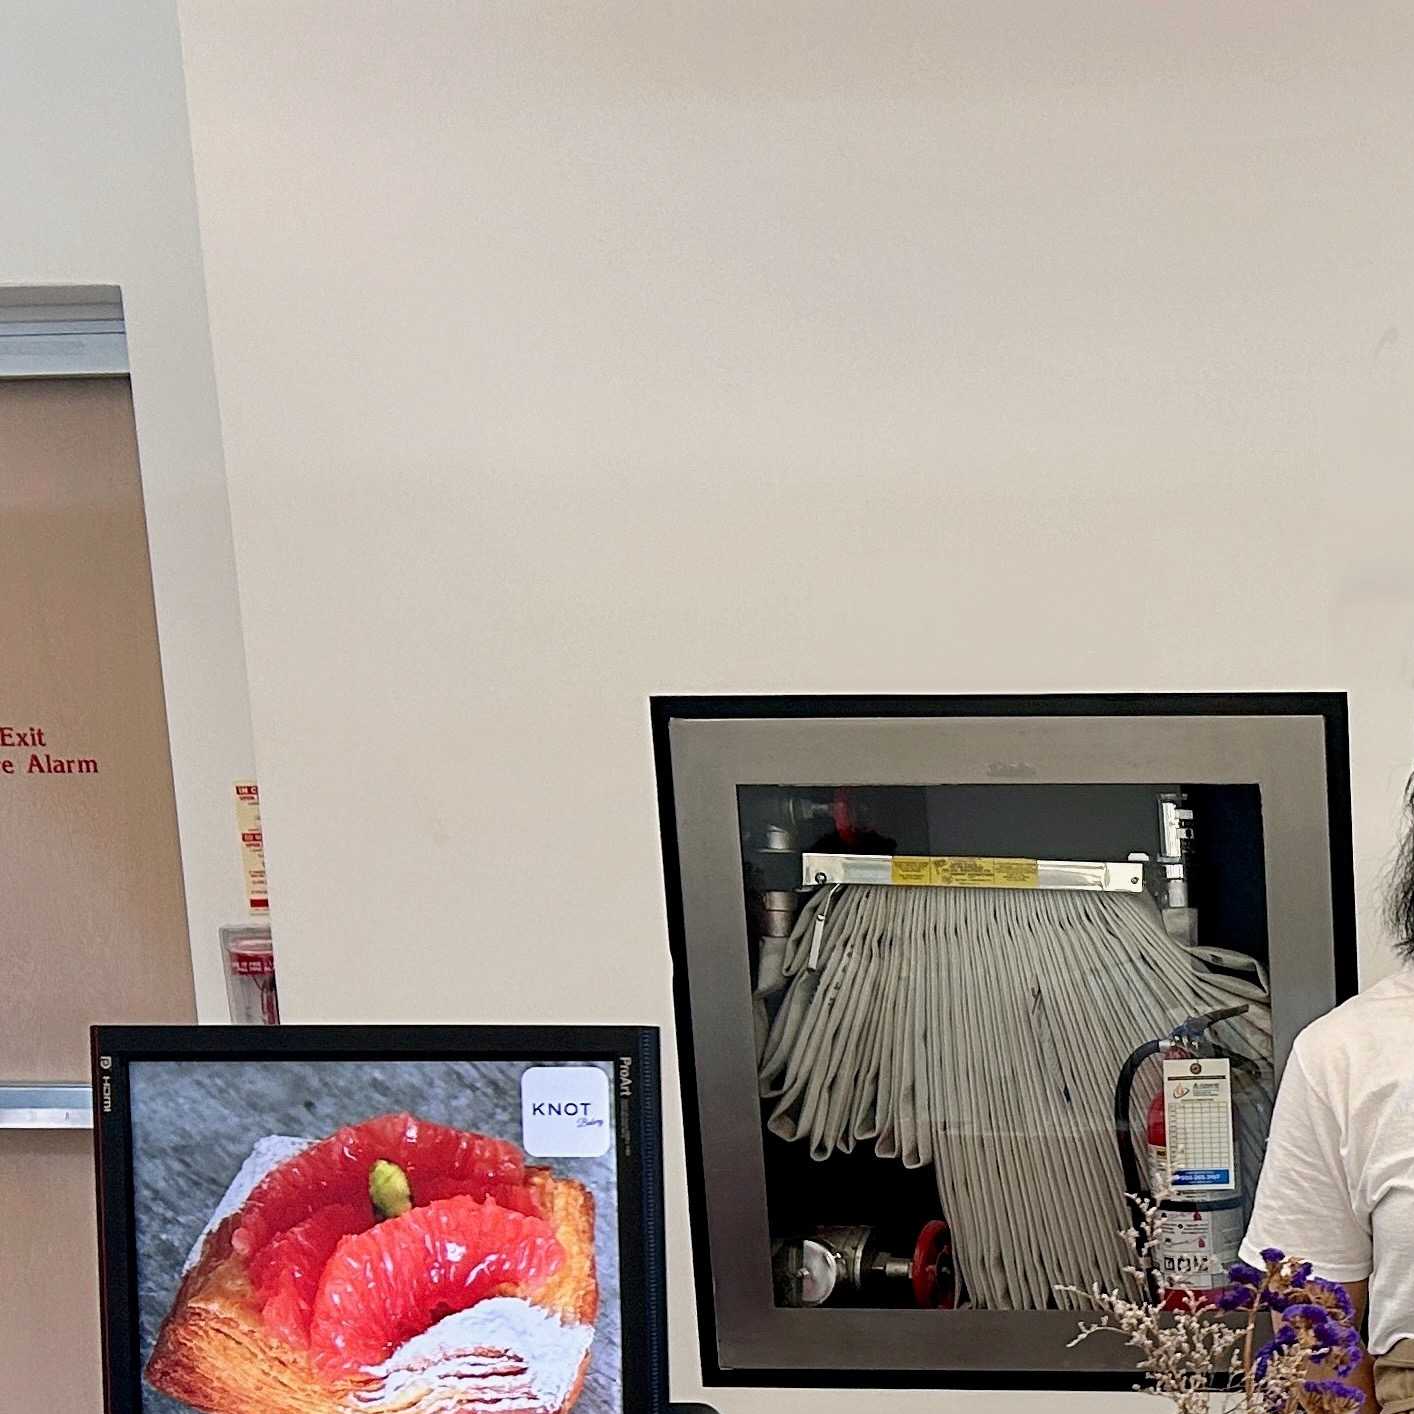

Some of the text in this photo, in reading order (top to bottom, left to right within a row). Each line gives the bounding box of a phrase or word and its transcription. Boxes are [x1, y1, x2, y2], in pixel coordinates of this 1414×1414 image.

[0, 727, 47, 747] Exit
[28, 753, 99, 774] Alarm
[620, 1056, 632, 1097] ProArt
[532, 1102, 592, 1116] KNOT
